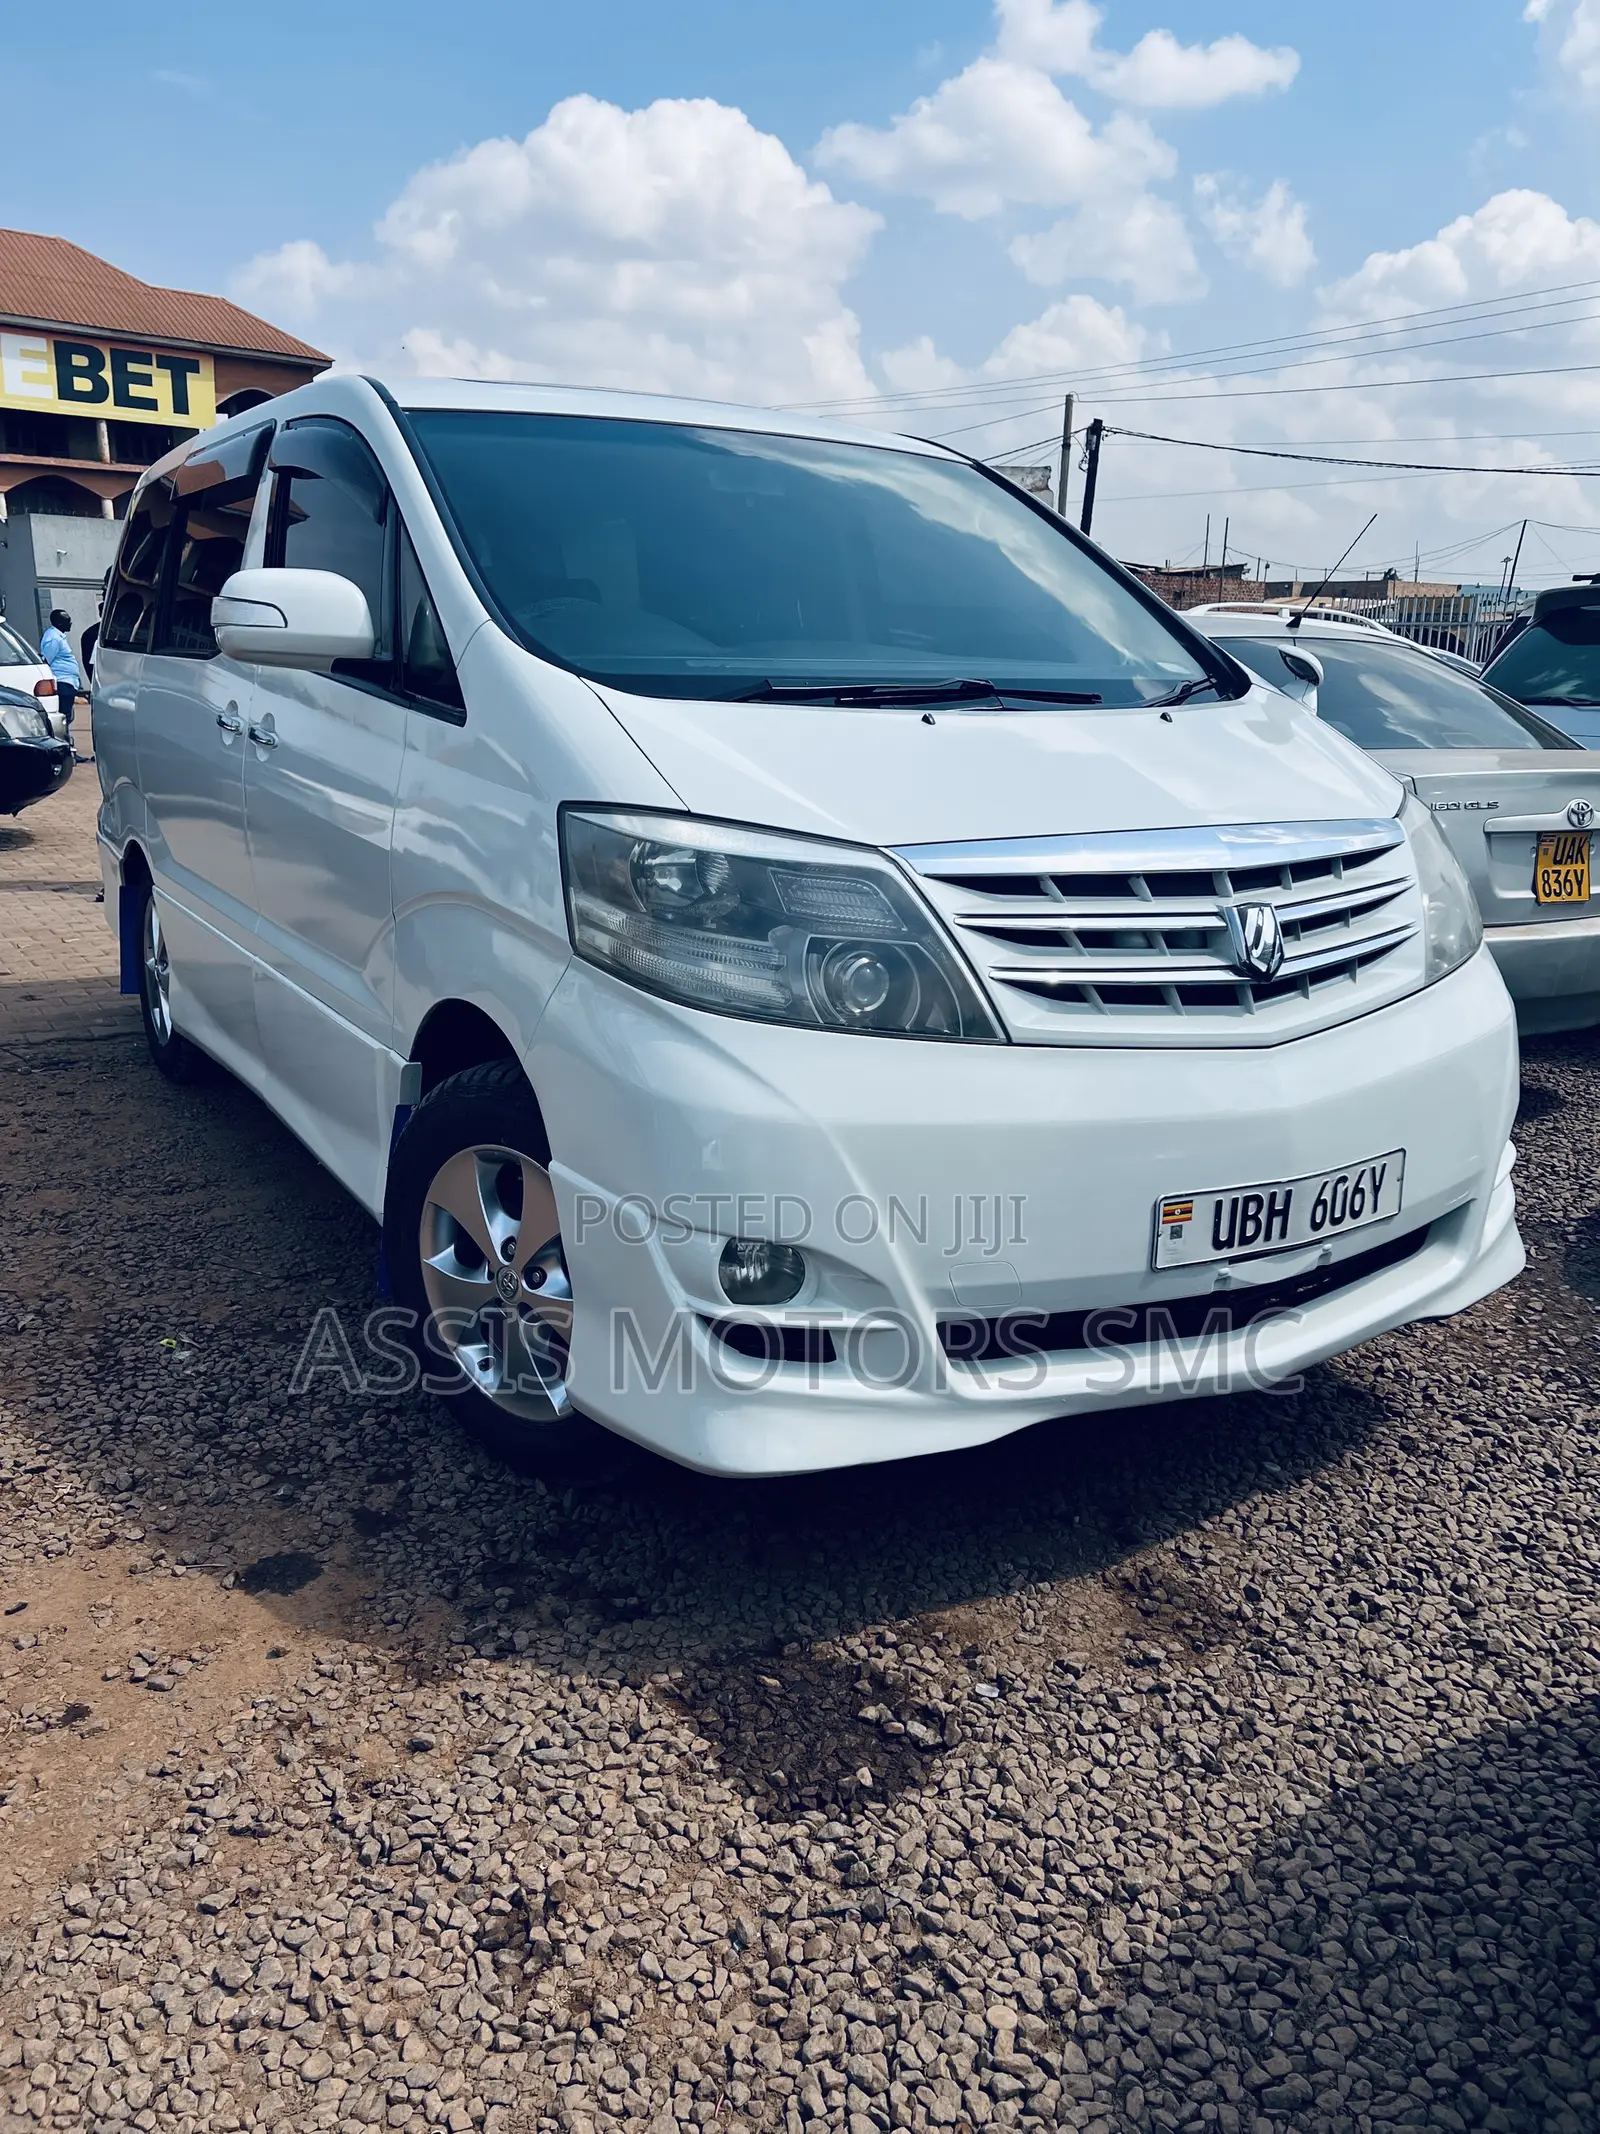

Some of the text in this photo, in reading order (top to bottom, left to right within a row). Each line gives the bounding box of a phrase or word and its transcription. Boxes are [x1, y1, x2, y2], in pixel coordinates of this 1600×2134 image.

[1464, 800, 1499, 811] GLS
[1552, 836, 1588, 865] UAK
[1541, 868, 1585, 898] 836Y
[1212, 1161, 1388, 1251] UBH 606Y
